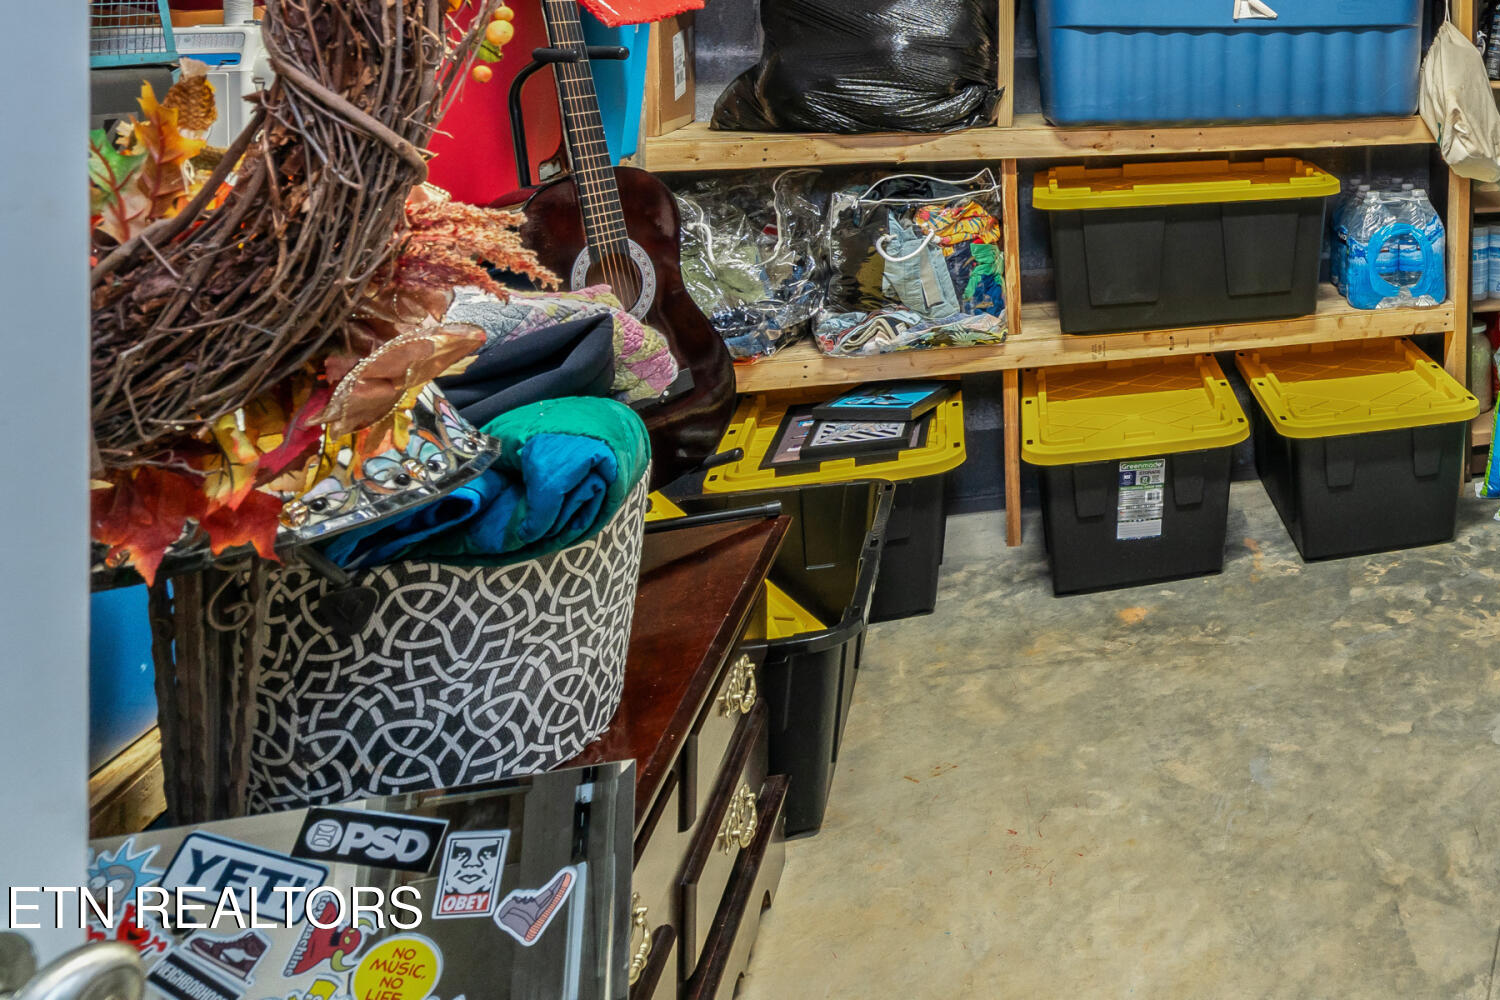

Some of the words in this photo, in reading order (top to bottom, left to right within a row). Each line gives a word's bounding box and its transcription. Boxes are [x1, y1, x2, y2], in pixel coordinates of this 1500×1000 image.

[337, 821, 429, 863] PSD
[181, 847, 306, 910] YETI
[441, 893, 489, 915] OBEY
[392, 947, 417, 961] NO
[369, 958, 427, 980] MUSIC,
[379, 976, 404, 989] NO
